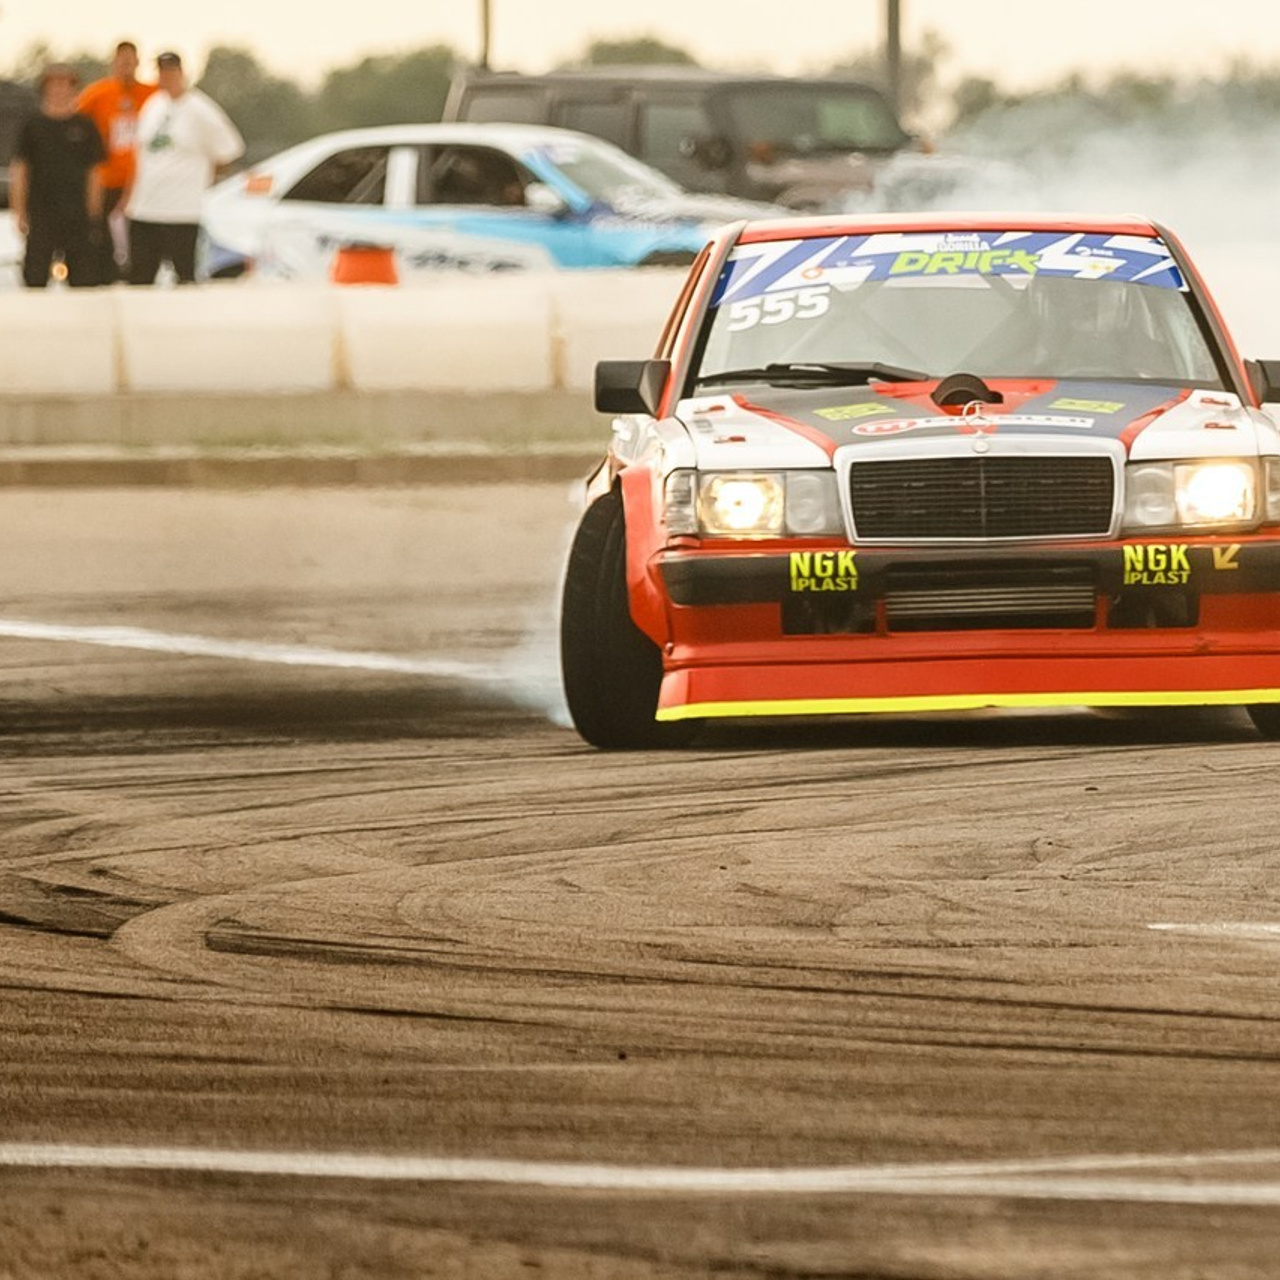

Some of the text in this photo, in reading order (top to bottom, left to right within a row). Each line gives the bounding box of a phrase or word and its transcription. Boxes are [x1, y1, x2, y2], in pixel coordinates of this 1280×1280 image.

[727, 286, 831, 332] 555
[789, 550, 858, 578] NGK
[1122, 543, 1191, 571] NGK
[798, 577, 858, 592] PLAST
[1130, 571, 1191, 585] PLAST
